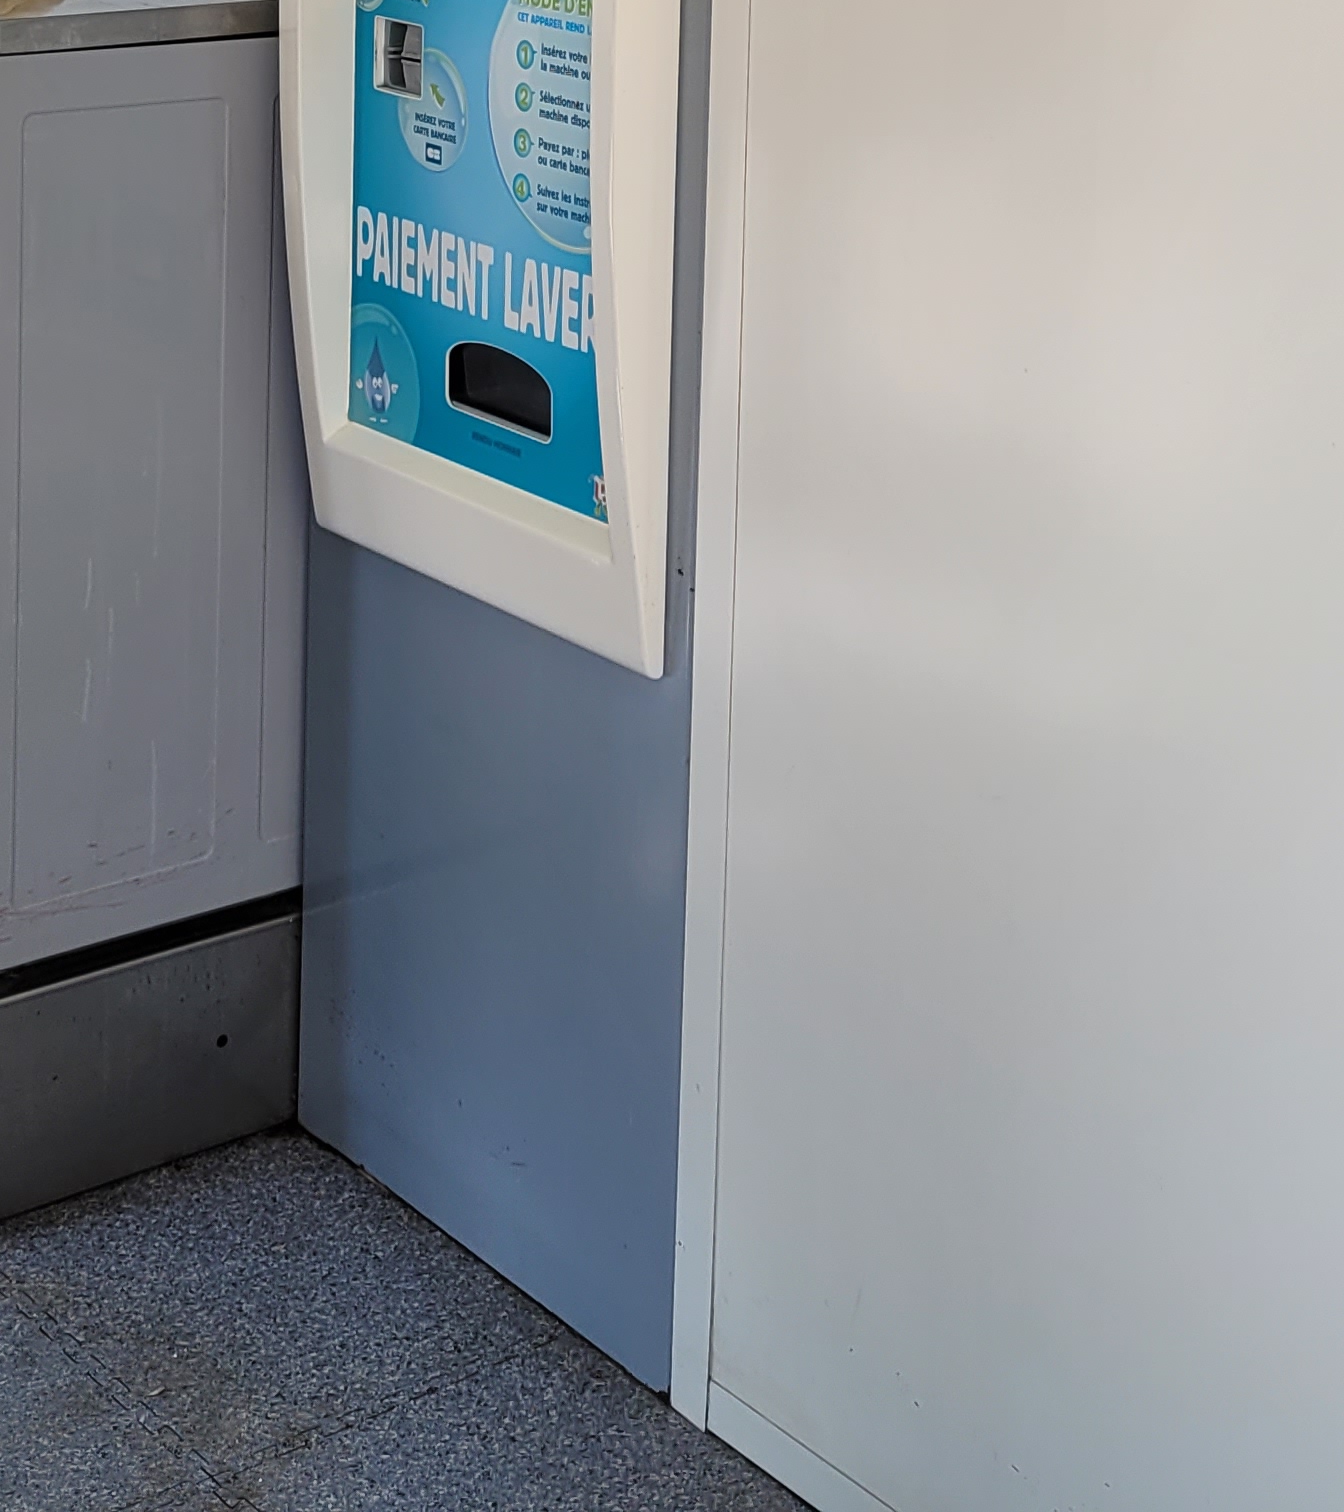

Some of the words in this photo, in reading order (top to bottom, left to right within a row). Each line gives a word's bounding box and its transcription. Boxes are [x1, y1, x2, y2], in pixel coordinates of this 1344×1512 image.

[518, 12, 529, 22] CET
[531, 14, 563, 30] APPAREIL
[566, 21, 585, 34] REND
[521, 46, 528, 64] 1
[541, 43, 566, 60] Insérez
[569, 51, 587, 64] votre
[541, 58, 547, 70] la
[549, 63, 579, 78] machine
[581, 71, 590, 80] ou
[520, 89, 528, 106] 2
[539, 90, 584, 112] Sélectionnez
[438, 118, 455, 131] VOTRE
[539, 109, 568, 124] machine
[414, 125, 429, 137] CARTE
[519, 135, 526, 152] 3
[538, 137, 560, 153] Payez
[562, 146, 574, 157] par
[538, 156, 547, 166] ou
[550, 158, 567, 171] carte
[517, 180, 524, 196] 4
[537, 184, 559, 201] Suivez
[561, 189, 571, 203] les
[537, 202, 548, 213] sur
[550, 203, 568, 219] votre
[356, 205, 494, 321] PAIEMENT
[504, 251, 596, 353] LAVER
